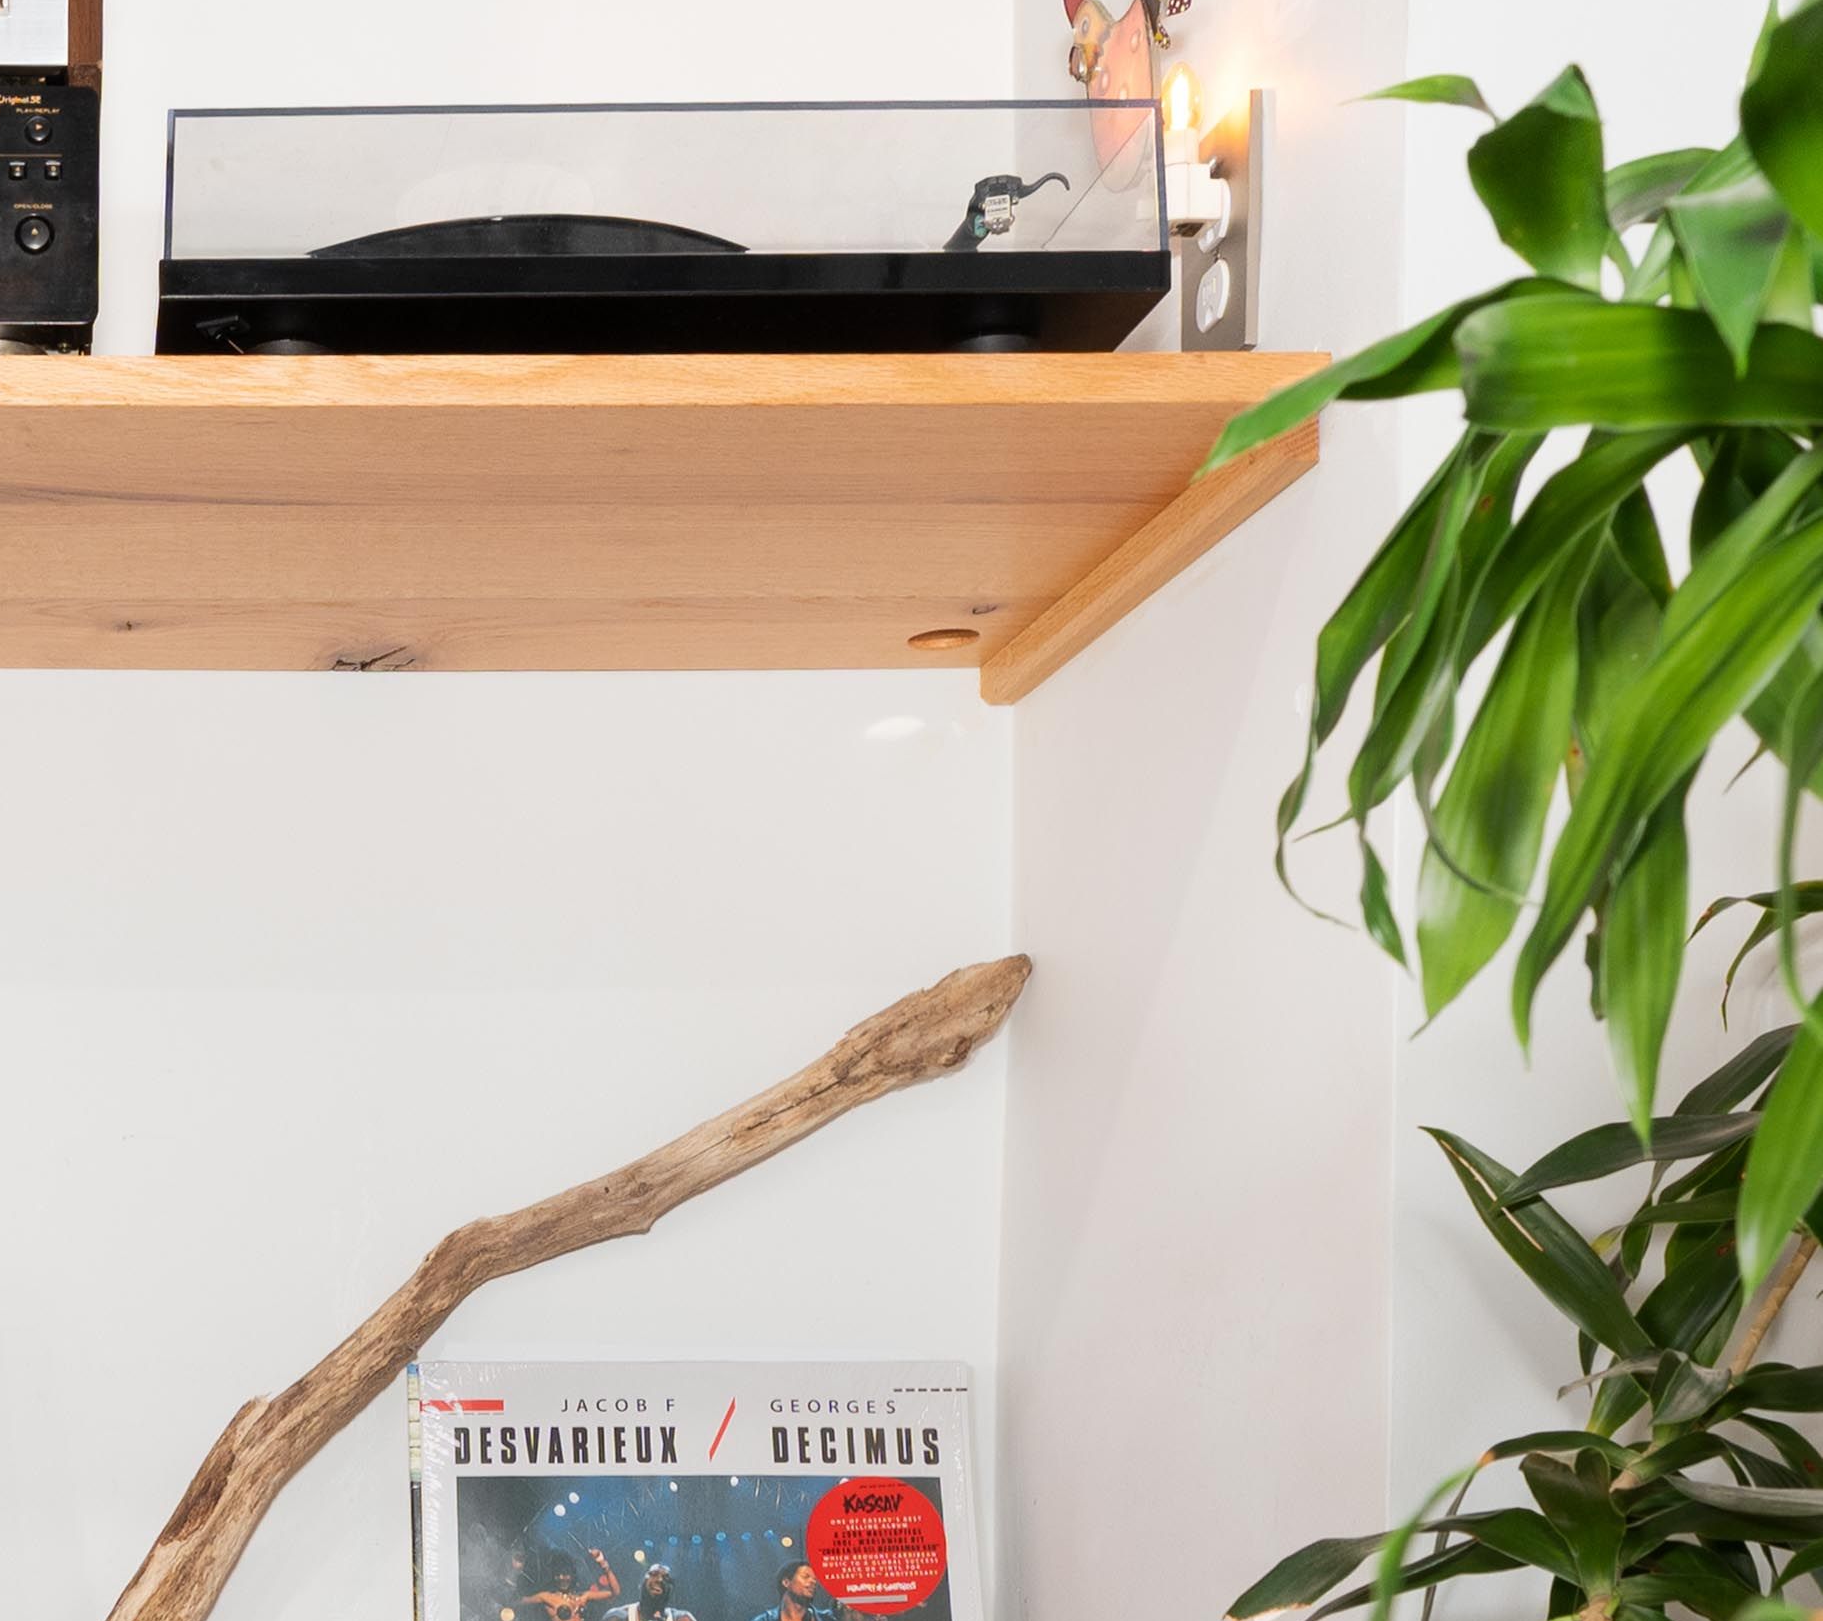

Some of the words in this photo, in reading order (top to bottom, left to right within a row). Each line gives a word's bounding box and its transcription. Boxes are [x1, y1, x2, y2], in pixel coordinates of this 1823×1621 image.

[561, 1397, 648, 1414] JACOB
[666, 1397, 677, 1413] F
[769, 1398, 897, 1415] GEORGES
[454, 1426, 678, 1465] DESVARIEUX
[771, 1426, 940, 1466] DECIMUS
[902, 1515, 922, 1523] BEST
[871, 1558, 902, 1566] GLOBAL
[905, 1557, 939, 1565] SUCCESS
